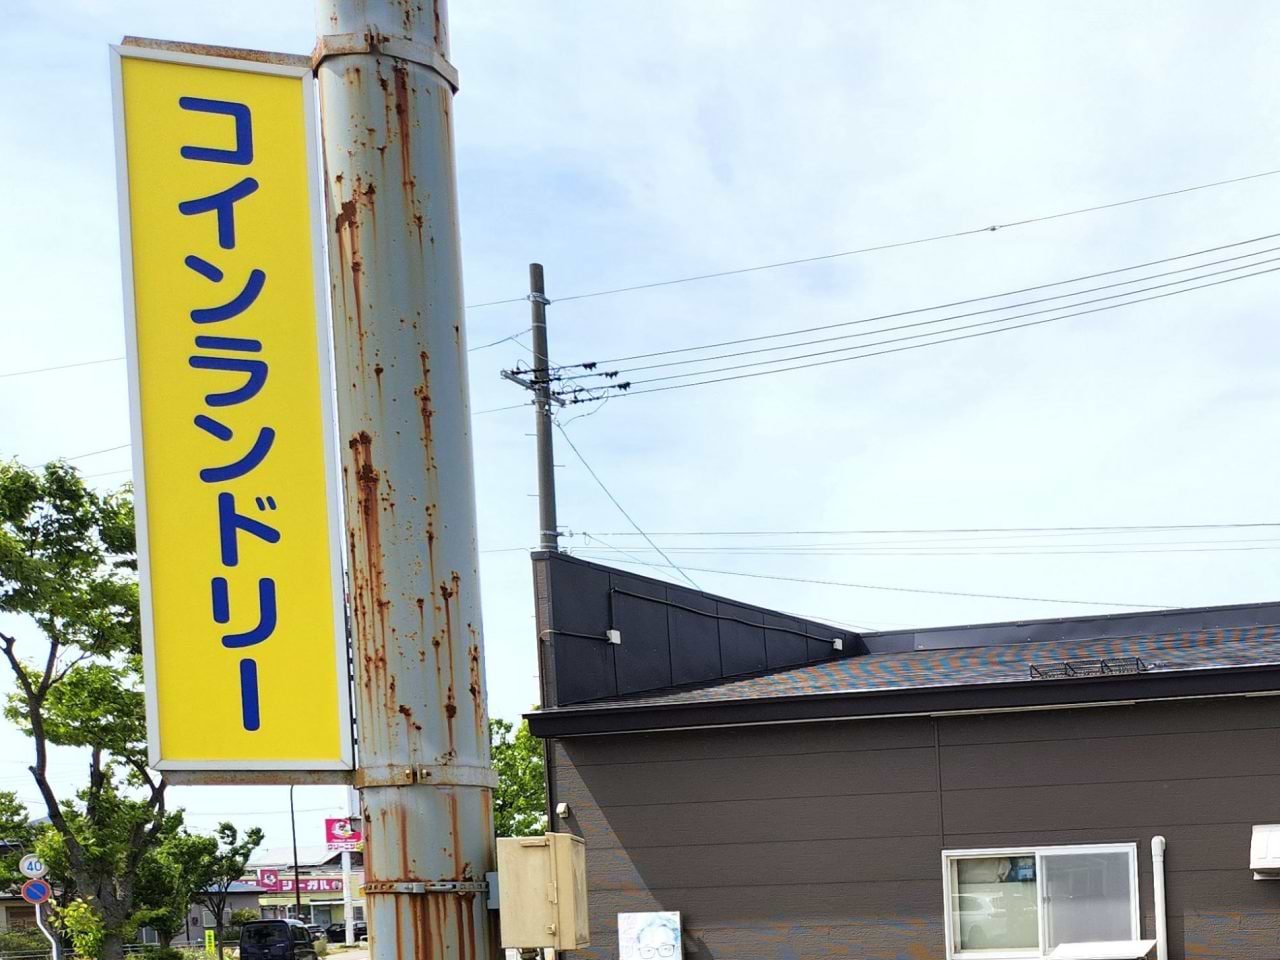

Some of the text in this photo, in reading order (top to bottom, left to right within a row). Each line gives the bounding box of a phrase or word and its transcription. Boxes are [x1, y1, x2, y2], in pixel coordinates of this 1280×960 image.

[177, 96, 282, 732] コインランドリー
[26, 858, 42, 871] 40
